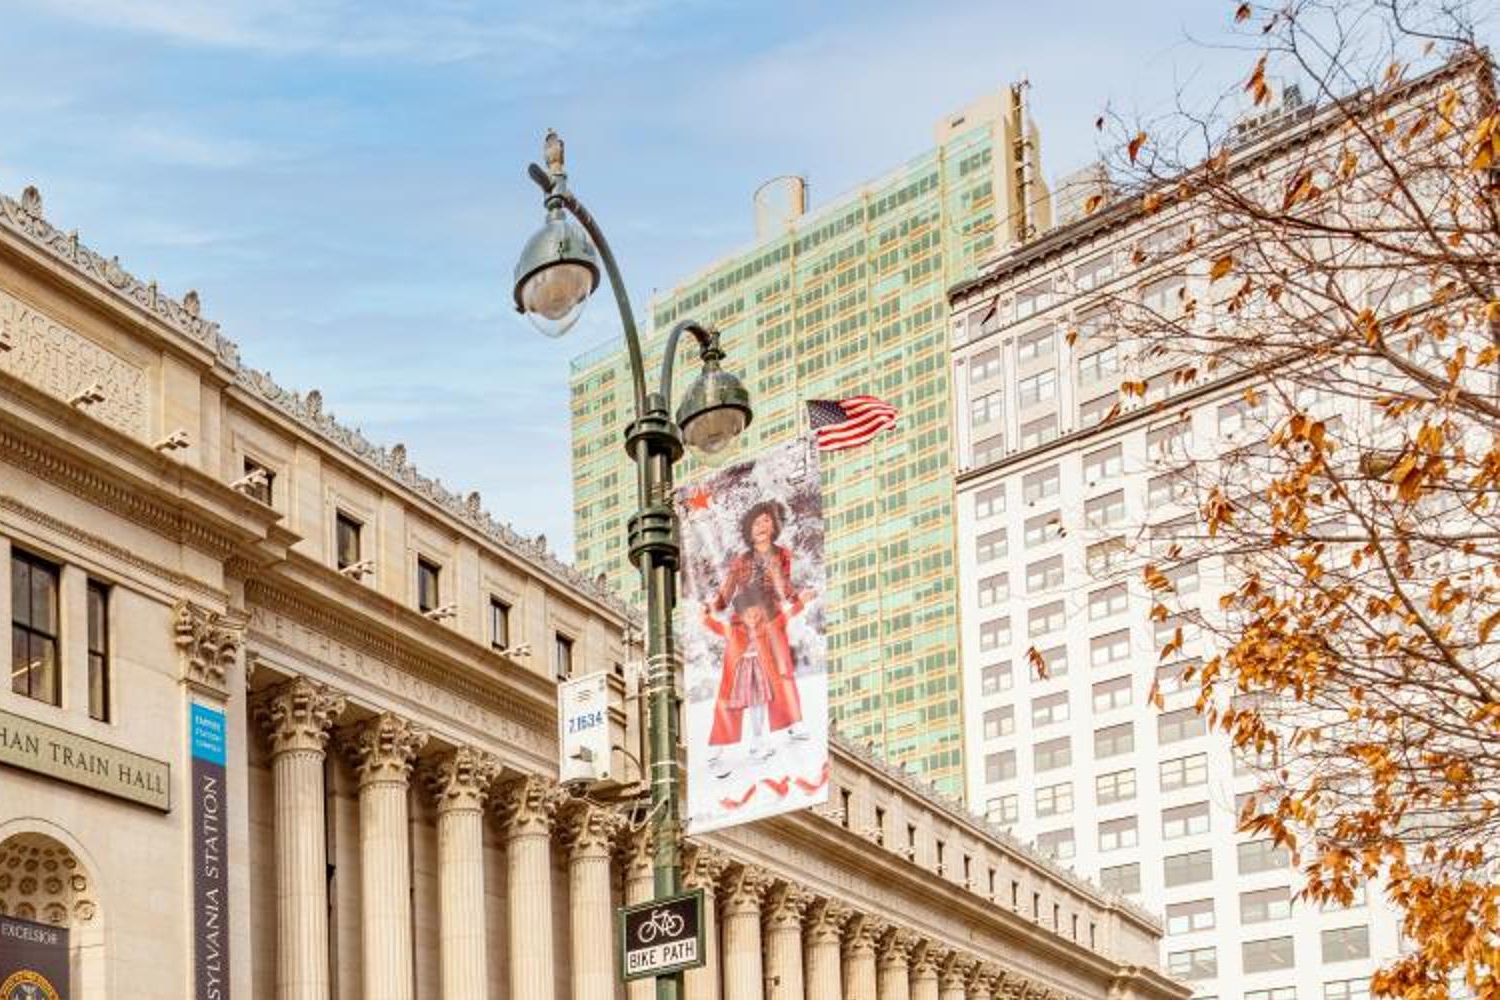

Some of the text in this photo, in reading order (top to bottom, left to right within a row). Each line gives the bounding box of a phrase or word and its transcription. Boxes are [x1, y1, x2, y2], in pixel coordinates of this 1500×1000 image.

[48, 742, 109, 776] TRAIN
[118, 764, 165, 795] HALL
[203, 775, 219, 879] STATION
[1, 922, 57, 945] EXCELSIOR
[629, 941, 694, 969] BIKE PATH
